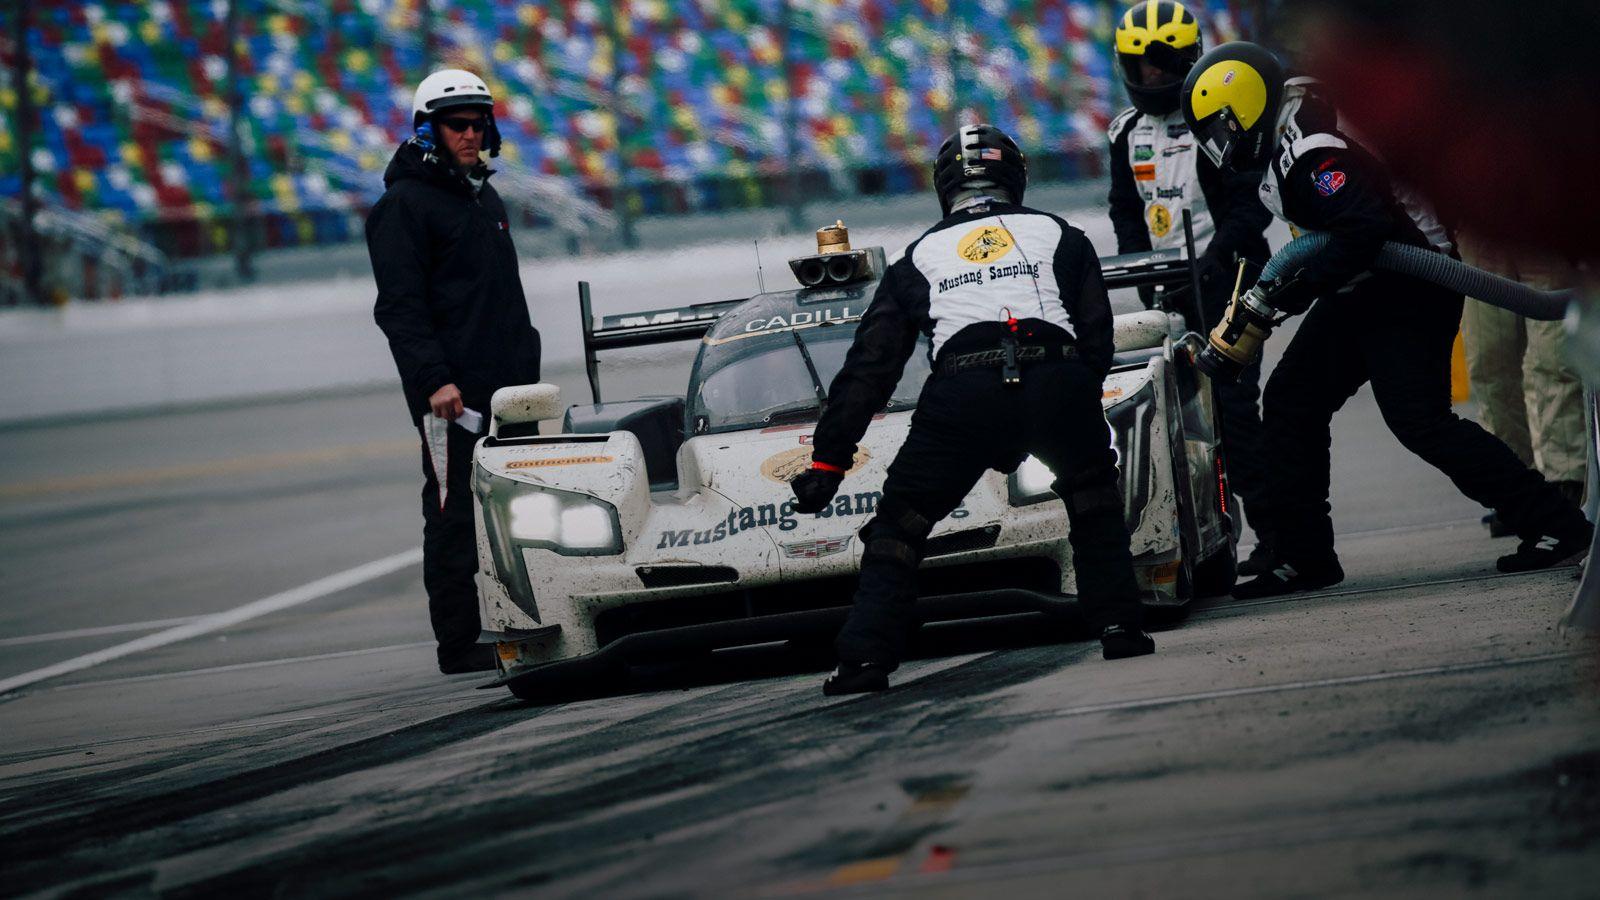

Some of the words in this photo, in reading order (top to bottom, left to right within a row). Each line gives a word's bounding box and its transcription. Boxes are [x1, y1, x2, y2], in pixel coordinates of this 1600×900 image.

[938, 269, 983, 294] Mustang
[989, 262, 1040, 281] Sampling
[745, 307, 869, 332] CADILL
[656, 497, 798, 550] Mustang
